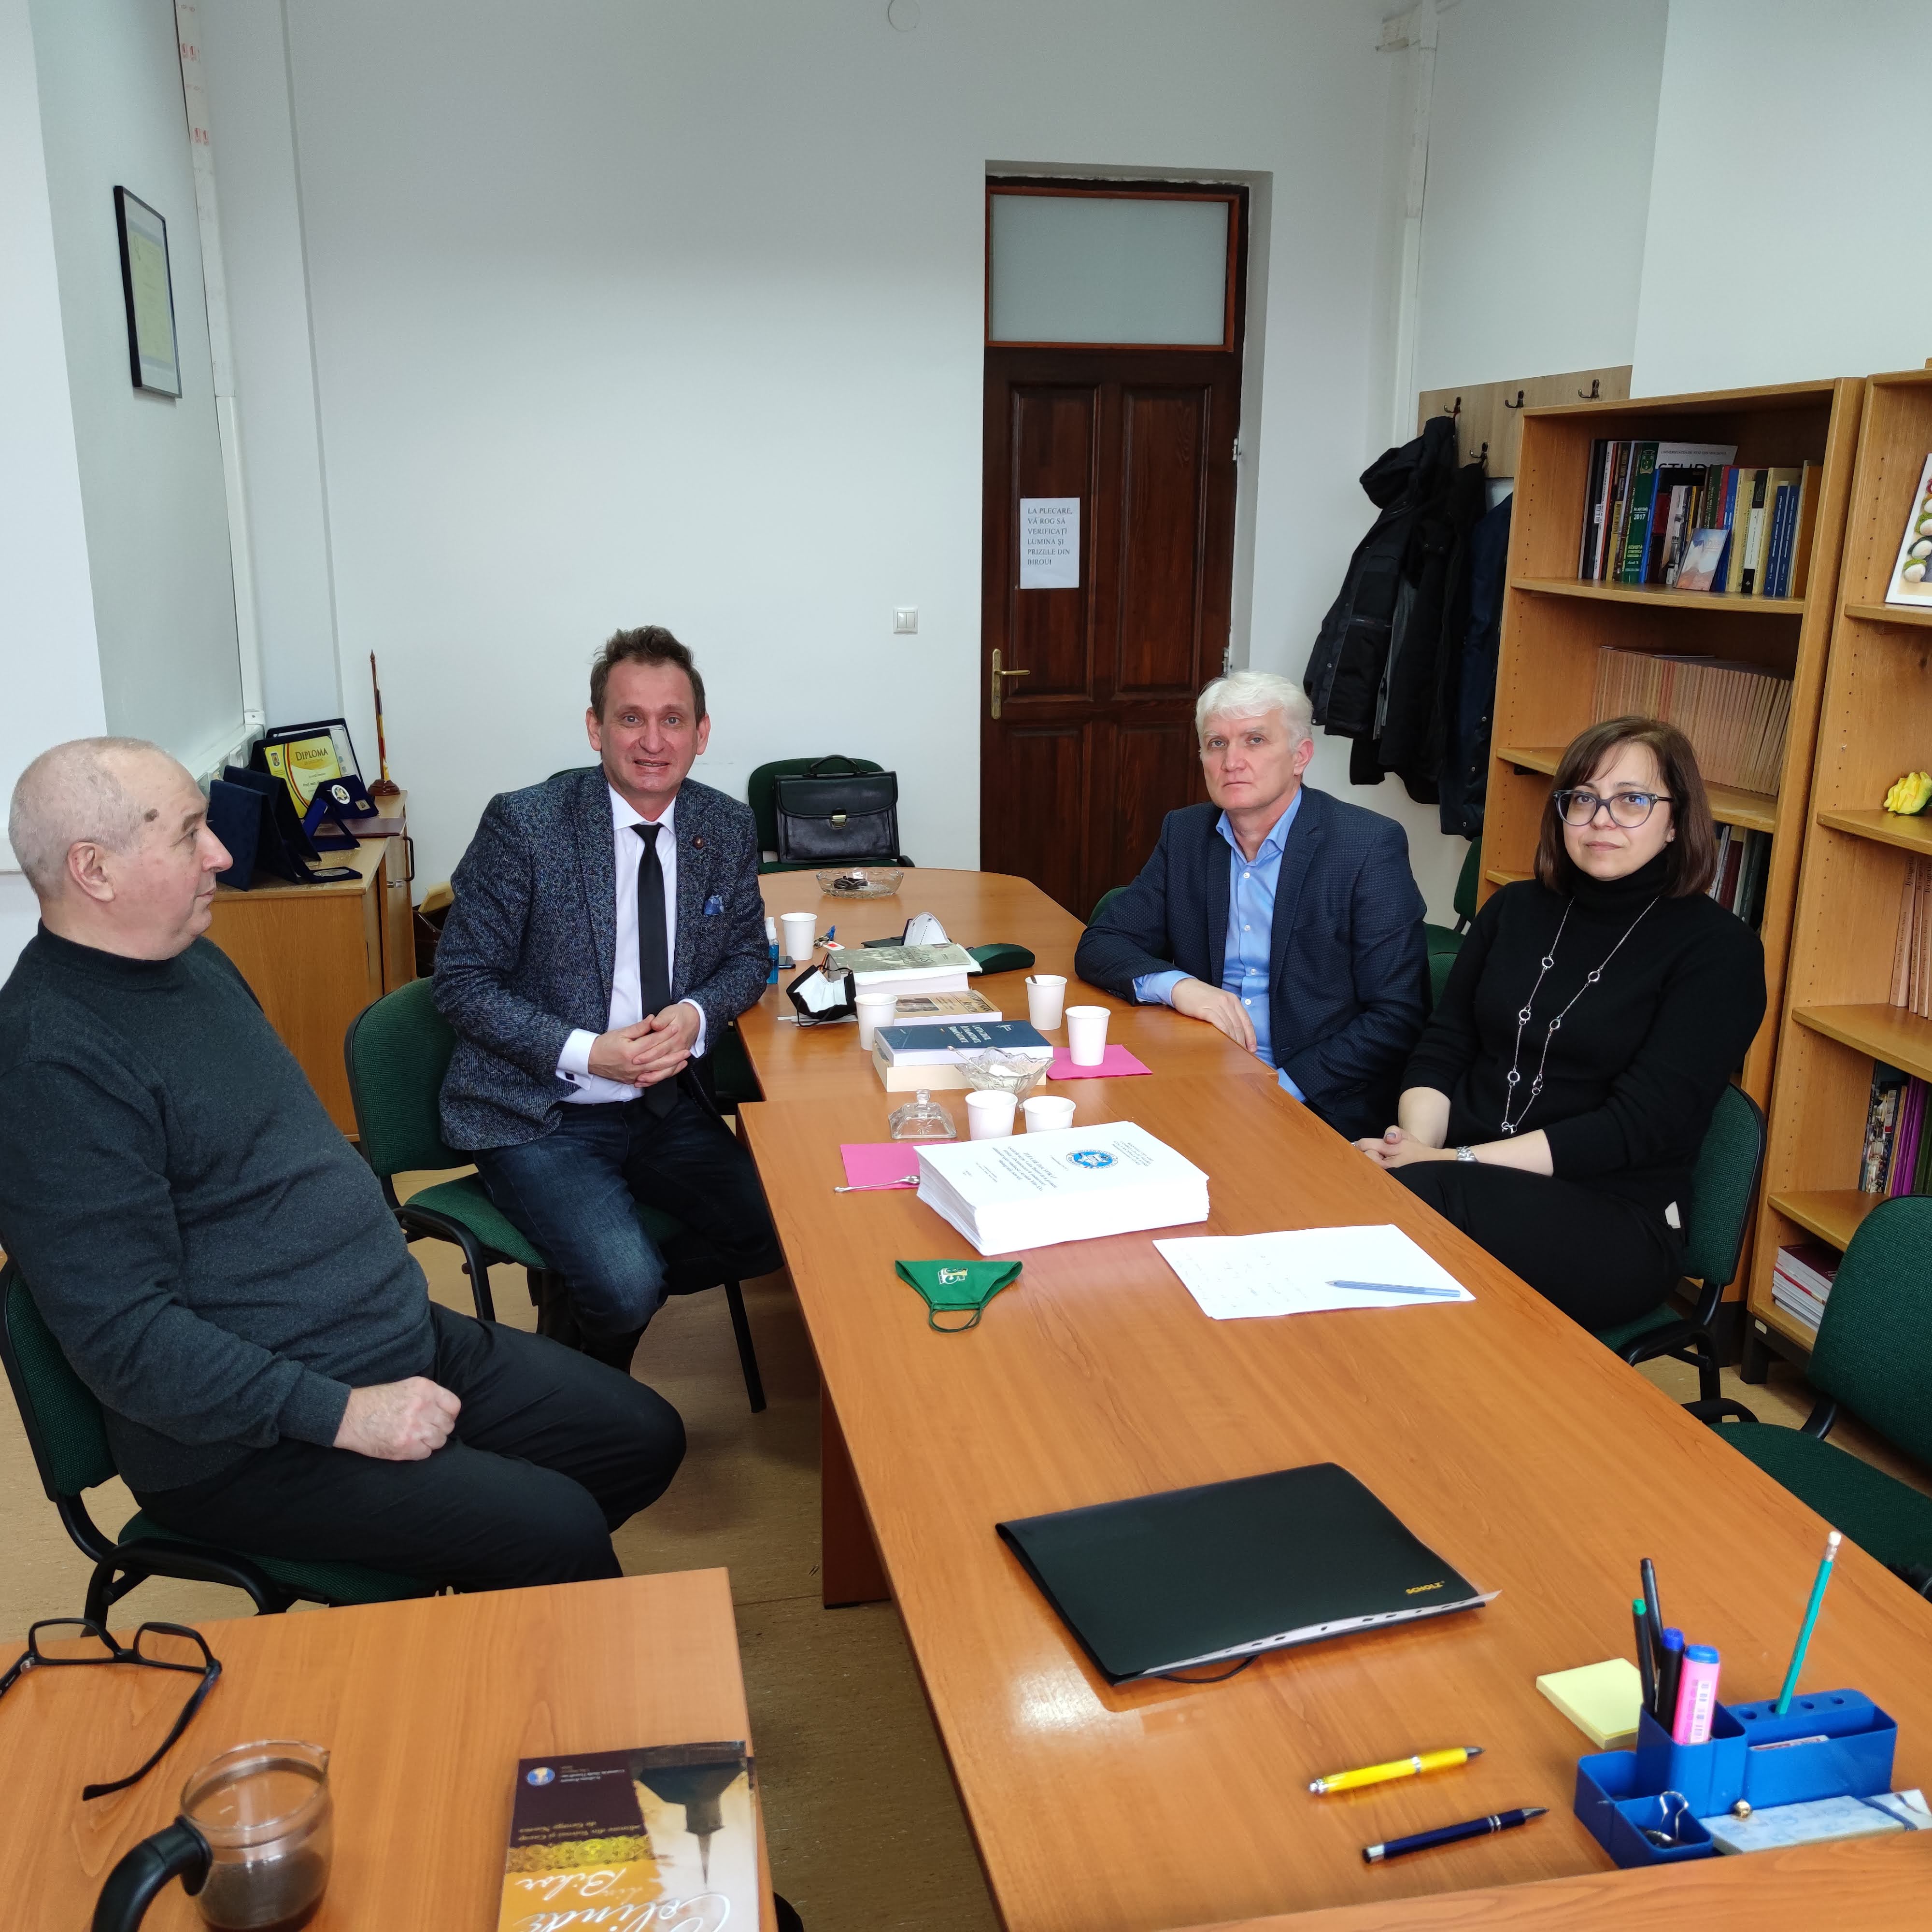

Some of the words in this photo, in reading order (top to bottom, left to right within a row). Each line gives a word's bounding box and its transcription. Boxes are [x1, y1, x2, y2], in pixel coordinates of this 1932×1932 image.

[295, 748, 328, 761] DIPLOMA
[1406, 1582, 1444, 1594] SCHOLZ
[515, 1868, 626, 1901] Bihor
